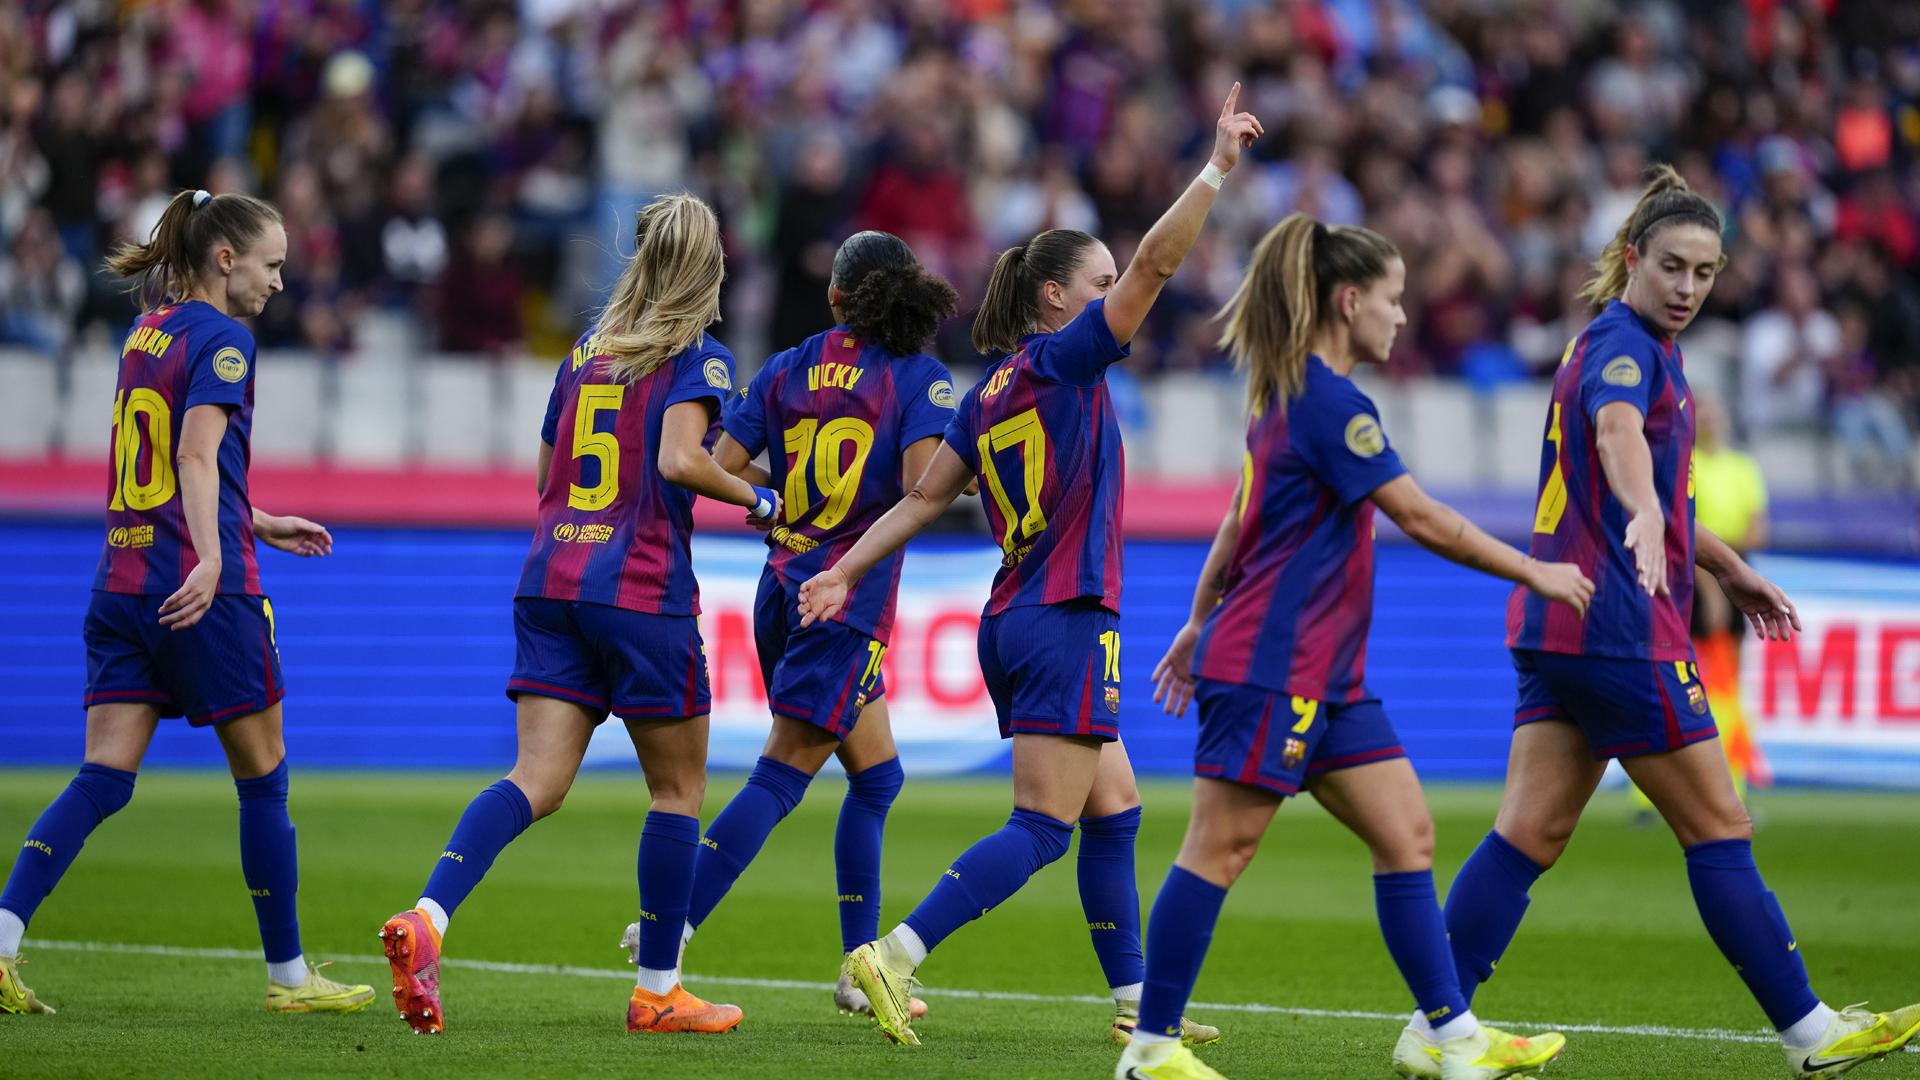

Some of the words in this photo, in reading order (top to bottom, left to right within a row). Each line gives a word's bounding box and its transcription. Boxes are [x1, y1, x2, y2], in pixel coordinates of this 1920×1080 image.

[808, 362, 864, 391] VICKY
[108, 387, 175, 511] 10
[568, 384, 625, 511] 5
[784, 417, 874, 530] 19
[977, 408, 1048, 554] 17
[577, 532, 610, 541] ACNUR
[581, 525, 614, 535] UNHCR
